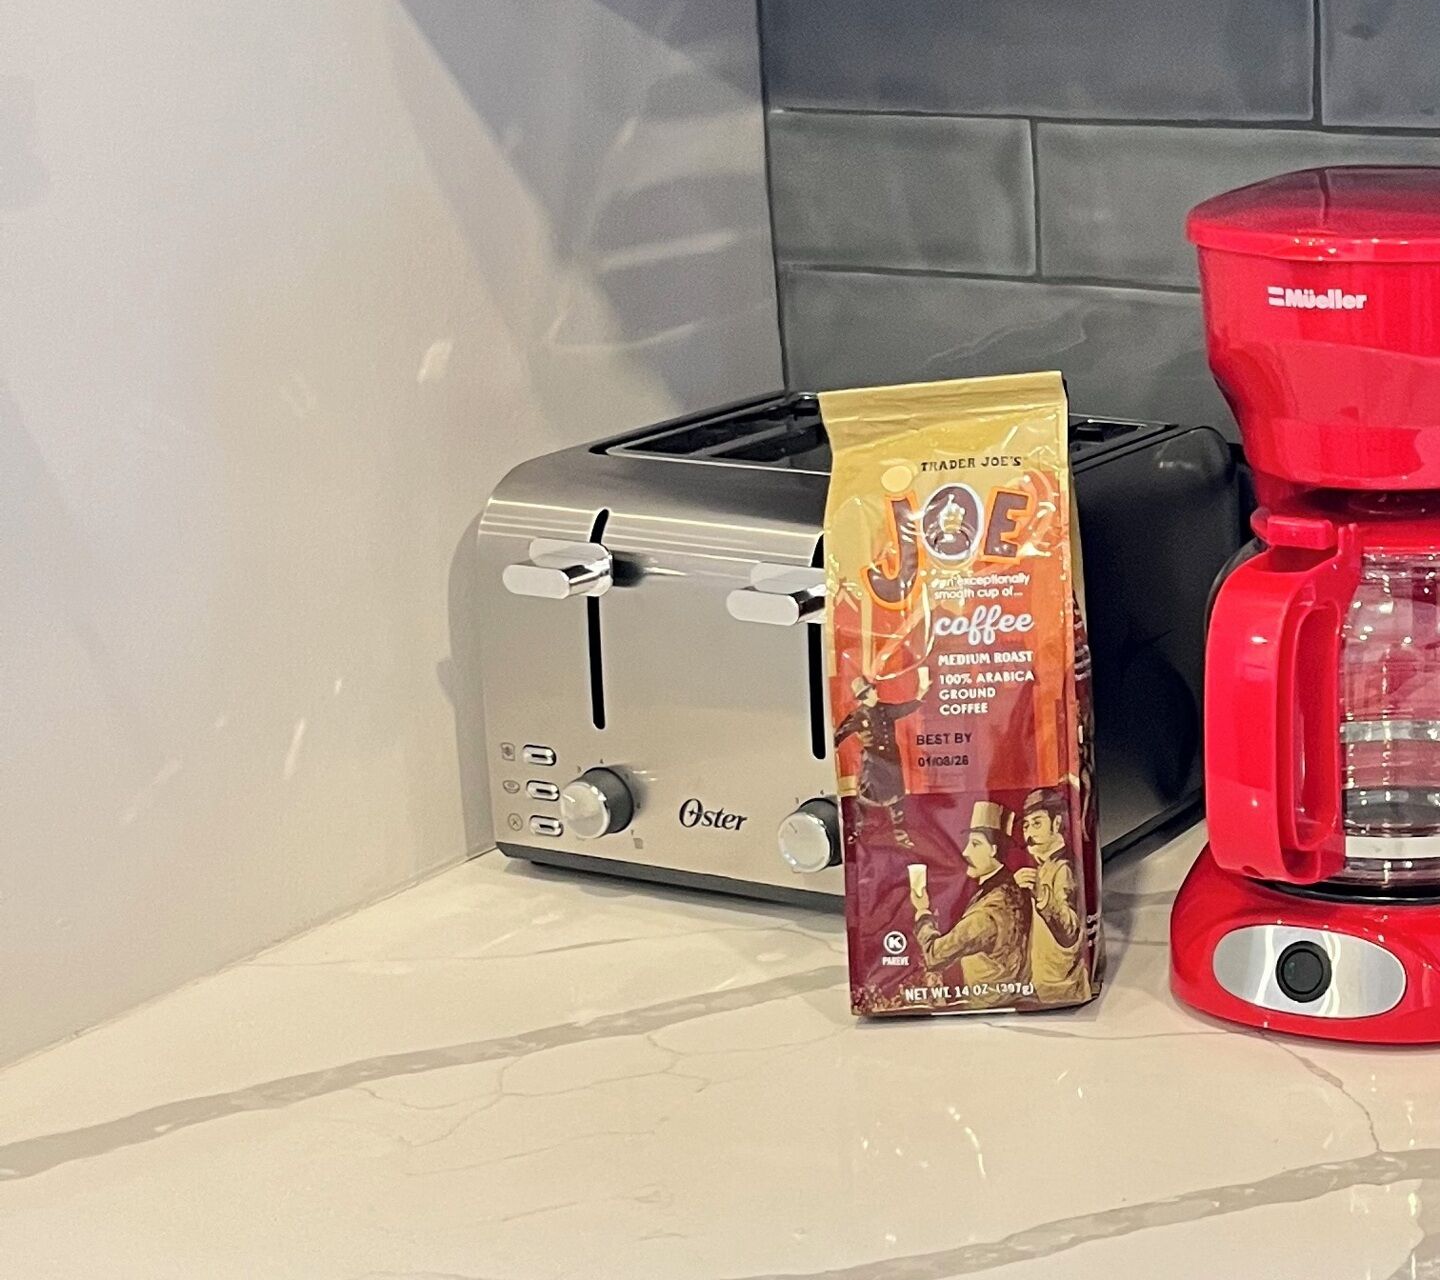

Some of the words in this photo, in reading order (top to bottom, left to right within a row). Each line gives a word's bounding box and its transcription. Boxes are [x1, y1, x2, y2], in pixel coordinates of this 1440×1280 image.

[920, 457, 975, 471] TRADER
[980, 456, 1022, 467] JOE'S
[977, 587, 1000, 599] cup
[934, 604, 1035, 646] coffee
[938, 652, 991, 666] MEDIUM
[993, 650, 1034, 663] ROAST
[939, 673, 973, 685] 100%
[976, 670, 1036, 683] ARABICA
[939, 687, 996, 700] GROUND
[939, 702, 988, 716] COFFEE
[916, 733, 951, 745] BEST
[954, 732, 972, 743] BY
[679, 798, 748, 831] Oster
[904, 987, 928, 1001] NET
[954, 987, 969, 998] 14
[973, 983, 989, 996] OZ
